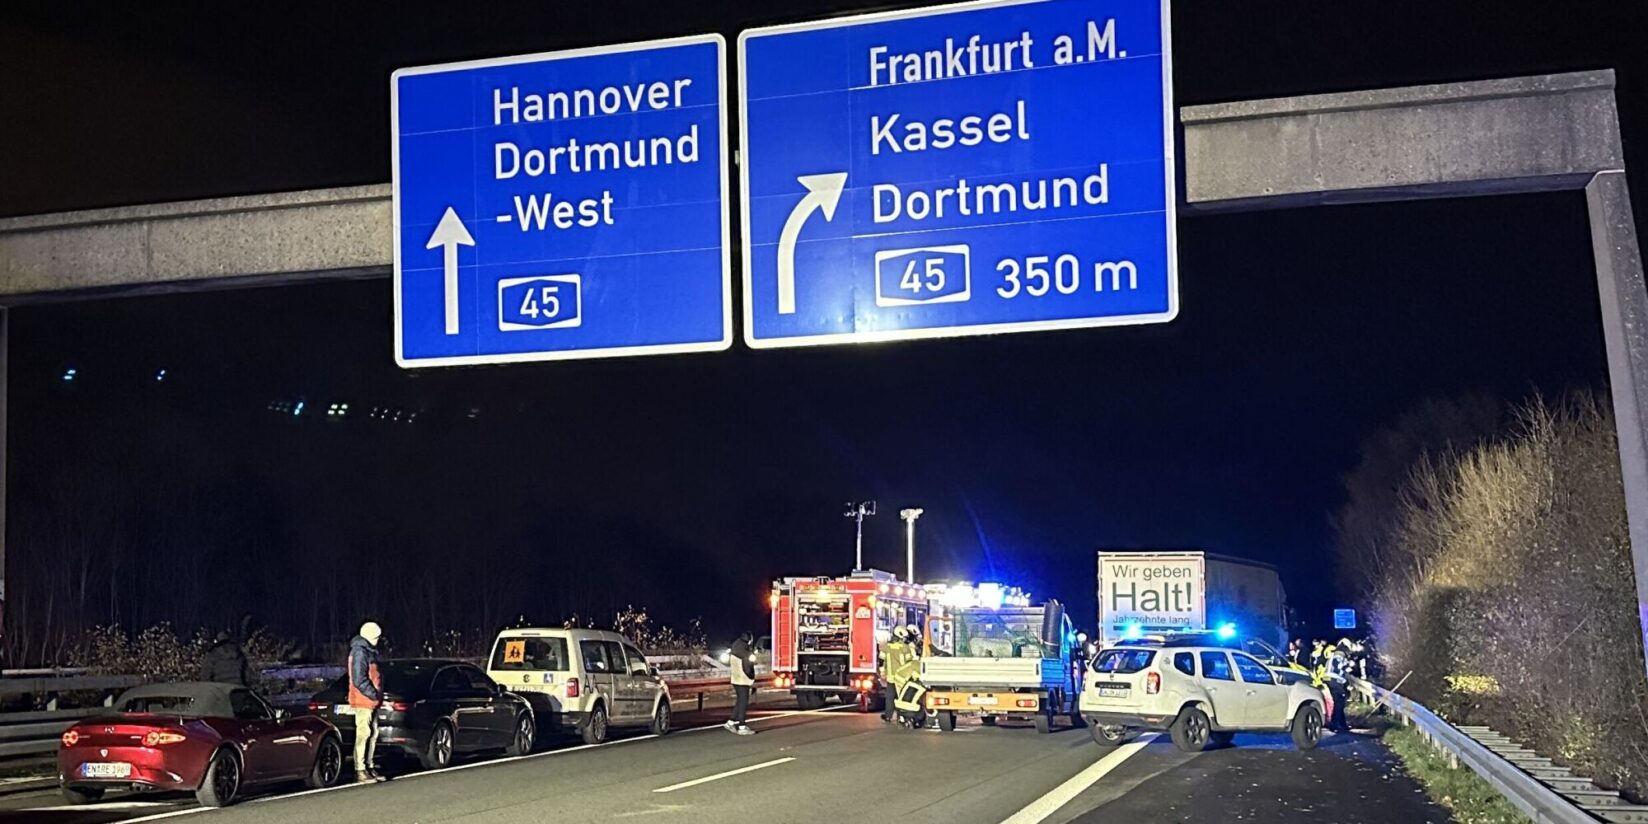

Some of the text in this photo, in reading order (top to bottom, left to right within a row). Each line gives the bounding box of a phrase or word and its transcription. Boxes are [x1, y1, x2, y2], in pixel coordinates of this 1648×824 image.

[869, 18, 1127, 87] Frankfurt a.M.
[494, 77, 692, 125] Hannover
[871, 100, 1029, 155] Kassel
[495, 124, 699, 180] Dortmund
[496, 190, 614, 232] -West
[873, 163, 1109, 223] Dortmund
[899, 254, 1137, 299] 45 350 m
[519, 286, 560, 319] 45
[1112, 564, 1192, 581] Wir geben
[1112, 581, 1193, 612] Halt!
